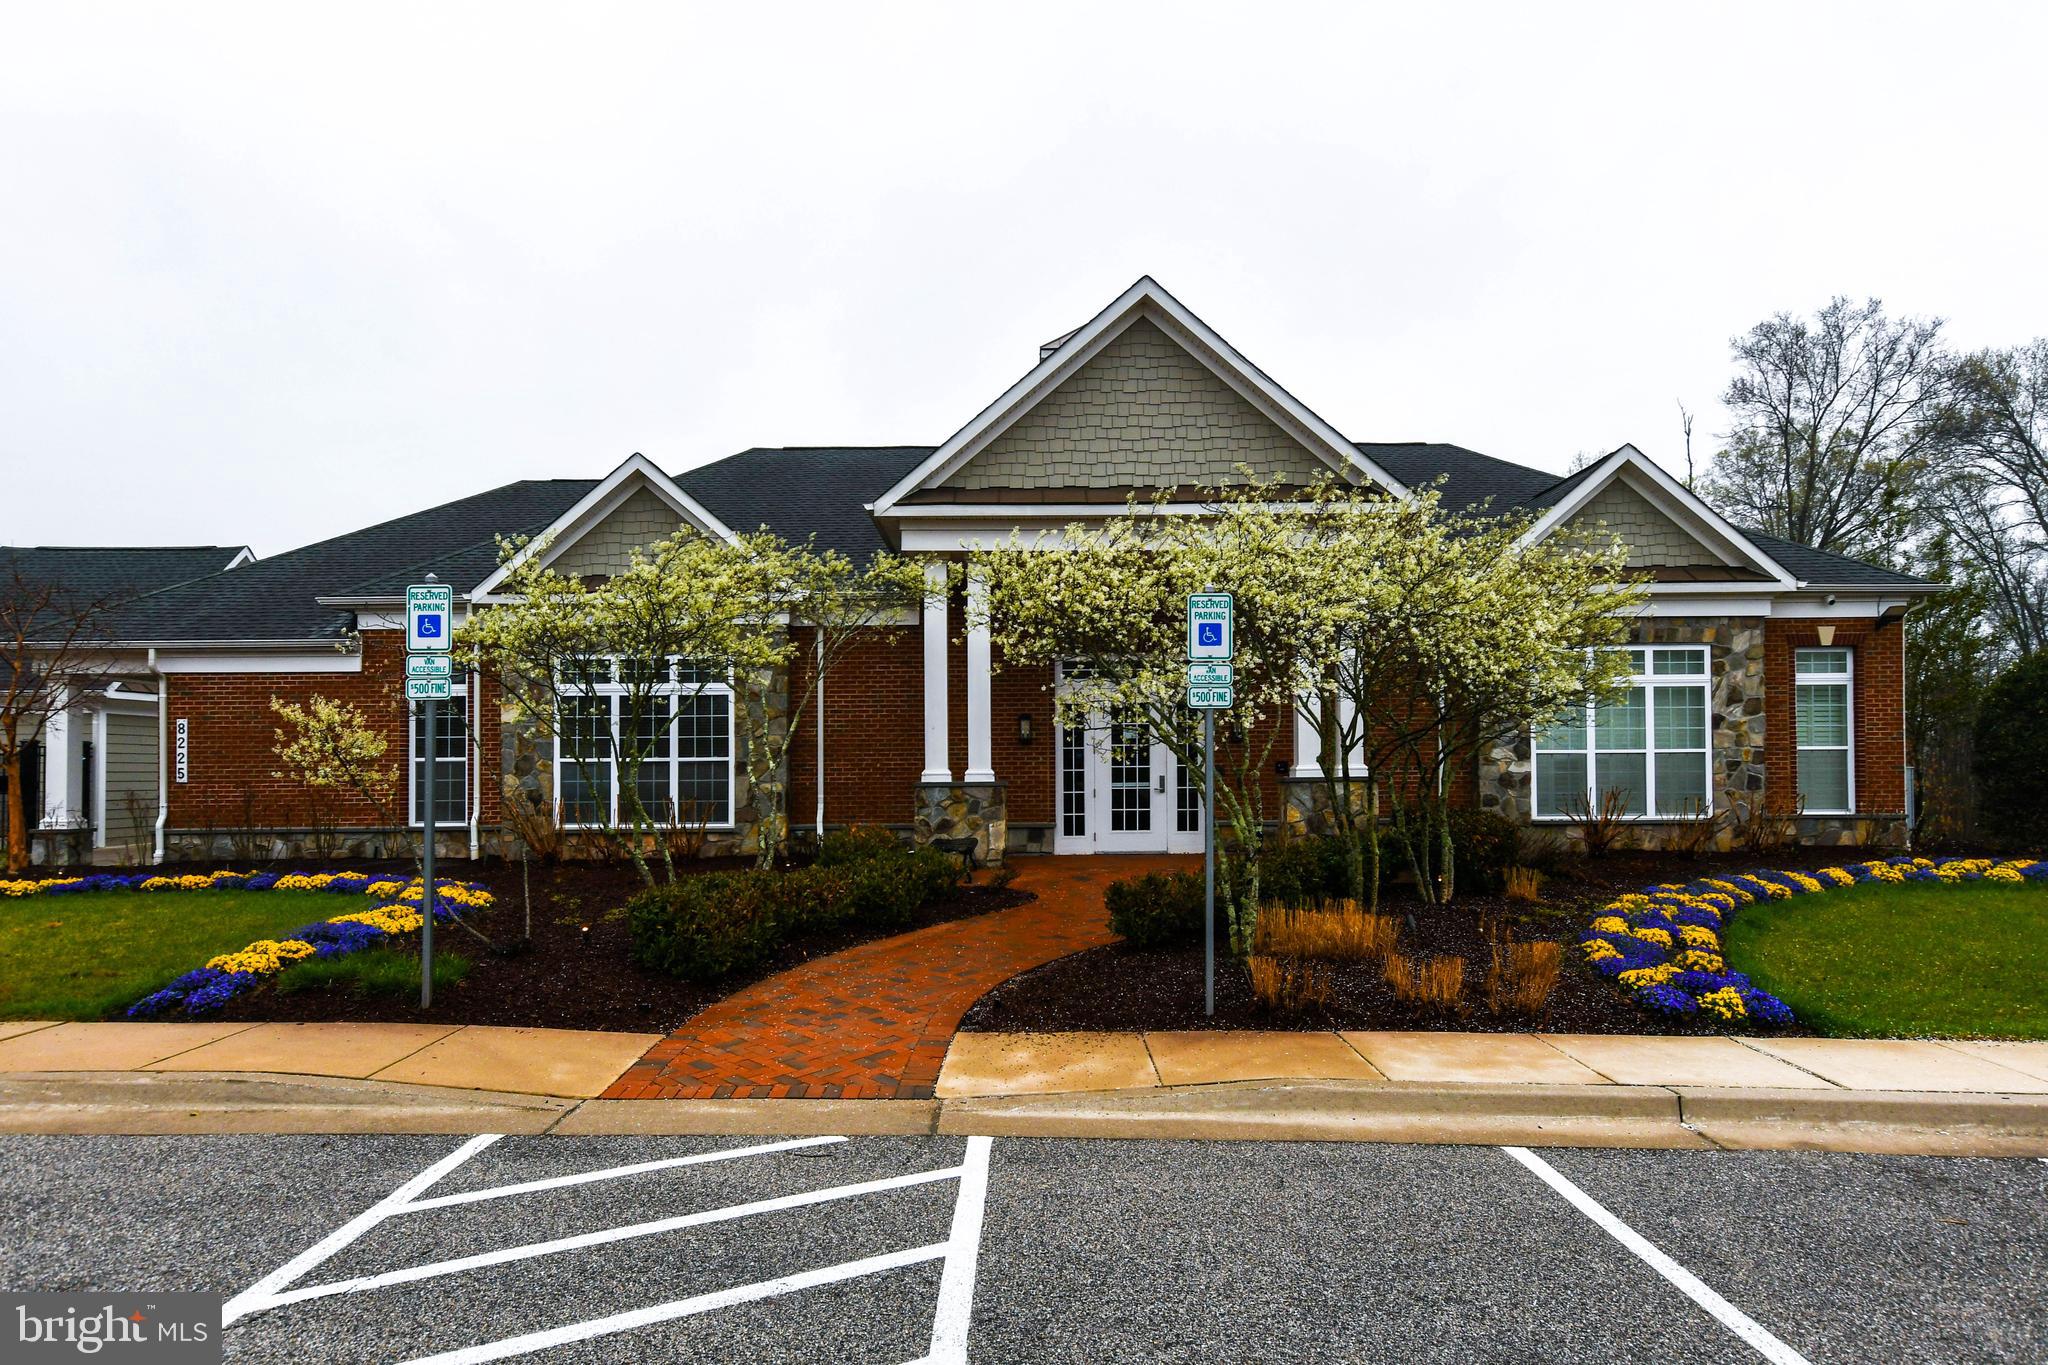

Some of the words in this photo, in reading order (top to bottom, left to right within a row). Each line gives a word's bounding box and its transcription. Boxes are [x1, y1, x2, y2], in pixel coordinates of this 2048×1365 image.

[411, 592, 448, 600] RESERVED
[414, 603, 445, 611] PARKING
[1192, 600, 1229, 609] RESERVED
[1195, 612, 1226, 620] PARKING
[411, 684, 429, 694] $500
[431, 684, 446, 693] FINE
[1193, 692, 1210, 702] $500
[1212, 692, 1228, 702] FINE
